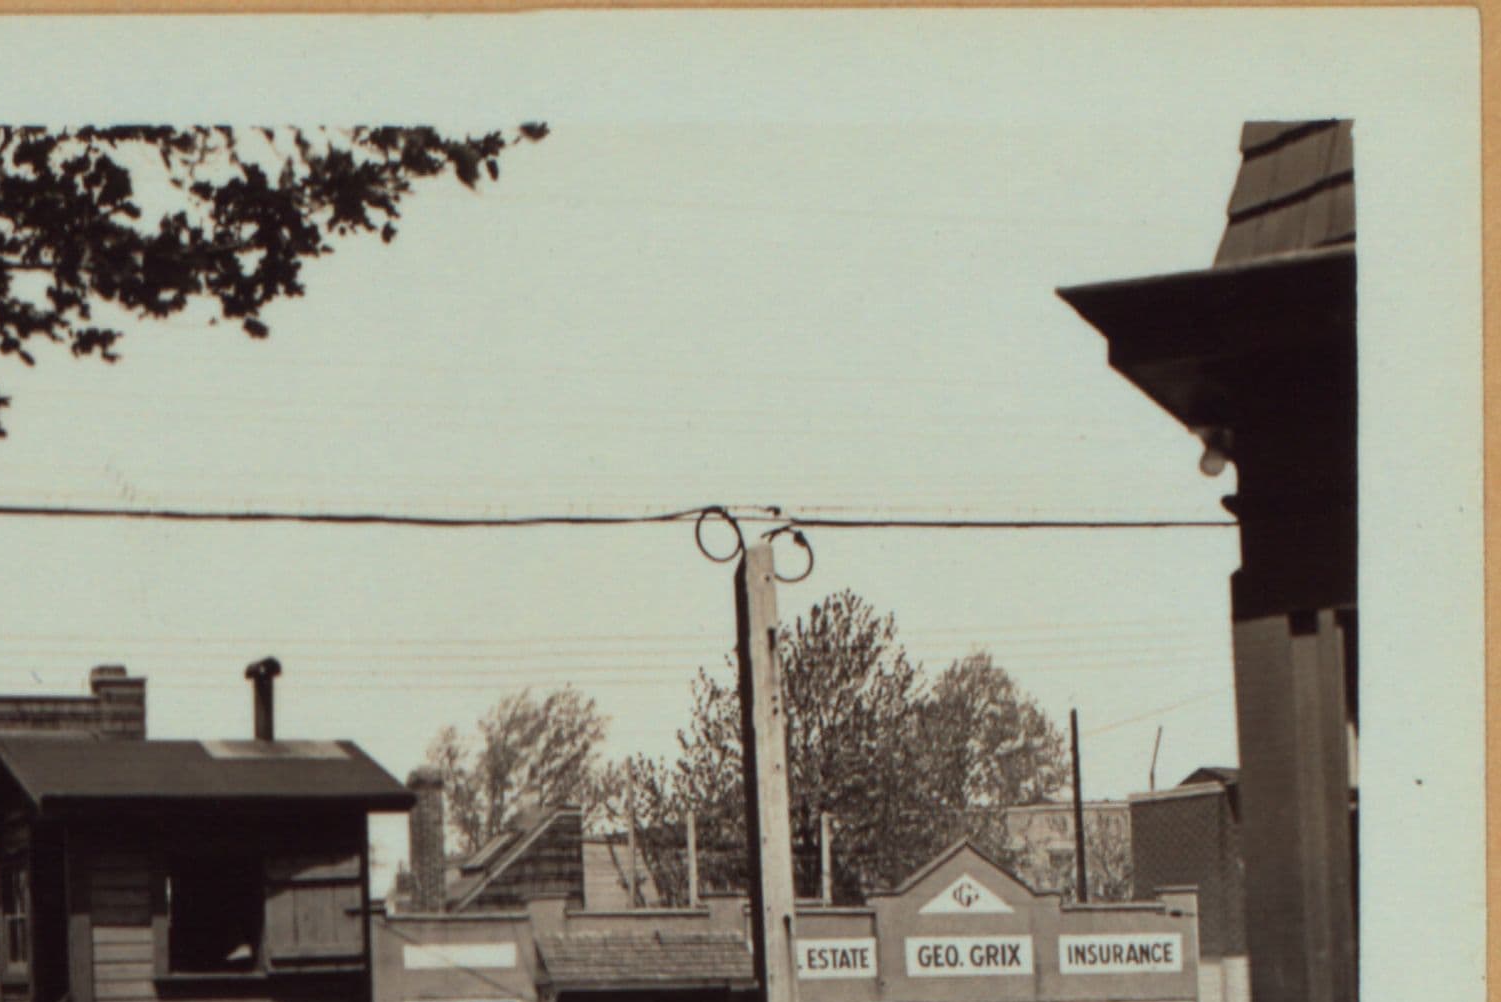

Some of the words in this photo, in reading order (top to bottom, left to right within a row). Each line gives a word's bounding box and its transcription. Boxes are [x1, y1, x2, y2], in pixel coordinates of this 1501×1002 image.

[807, 947, 870, 970] ESTATE
[917, 943, 965, 969] GEO.
[969, 942, 1021, 968] GRIX
[1067, 941, 1175, 966] INSURANCE
